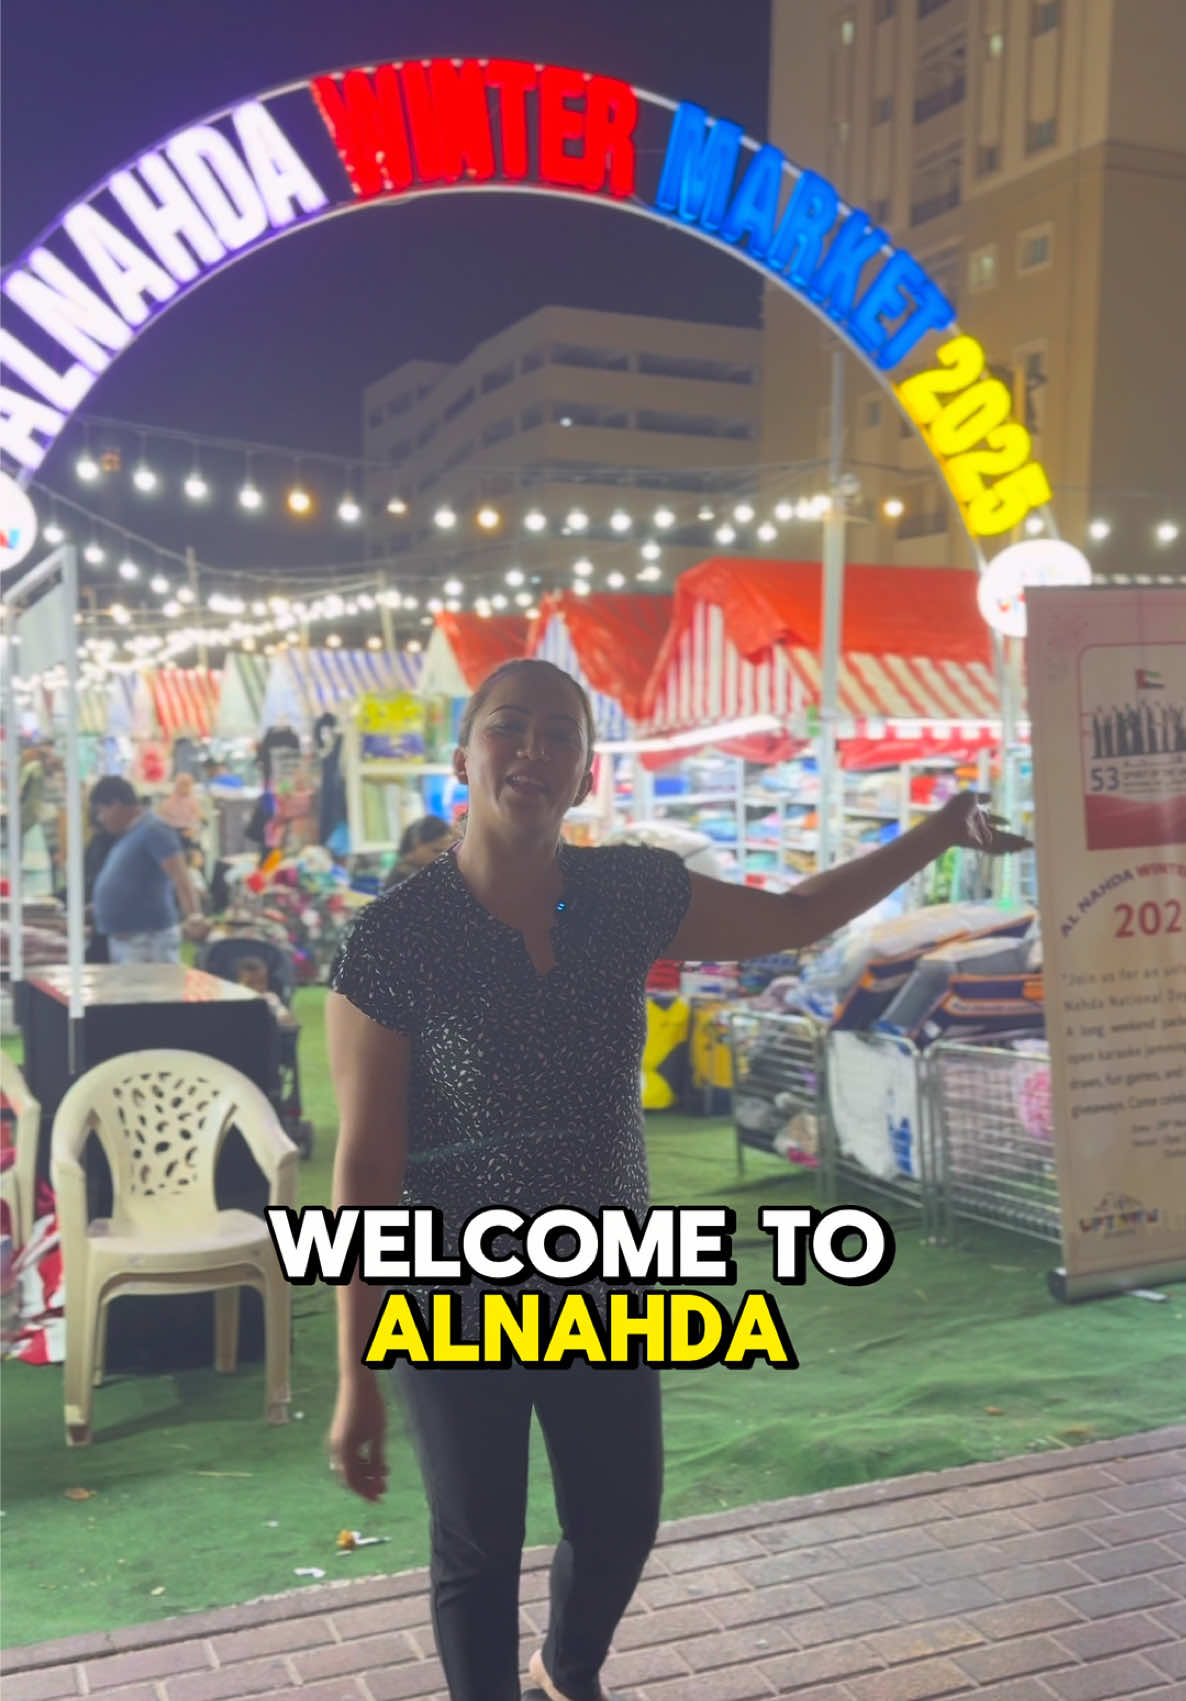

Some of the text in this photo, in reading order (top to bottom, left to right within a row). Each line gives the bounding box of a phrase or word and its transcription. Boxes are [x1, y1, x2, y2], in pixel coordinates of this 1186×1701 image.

[311, 58, 638, 203] WINTER
[647, 100, 957, 372] MARKET
[892, 334, 1053, 538] 2025
[1091, 767, 1119, 792] 53
